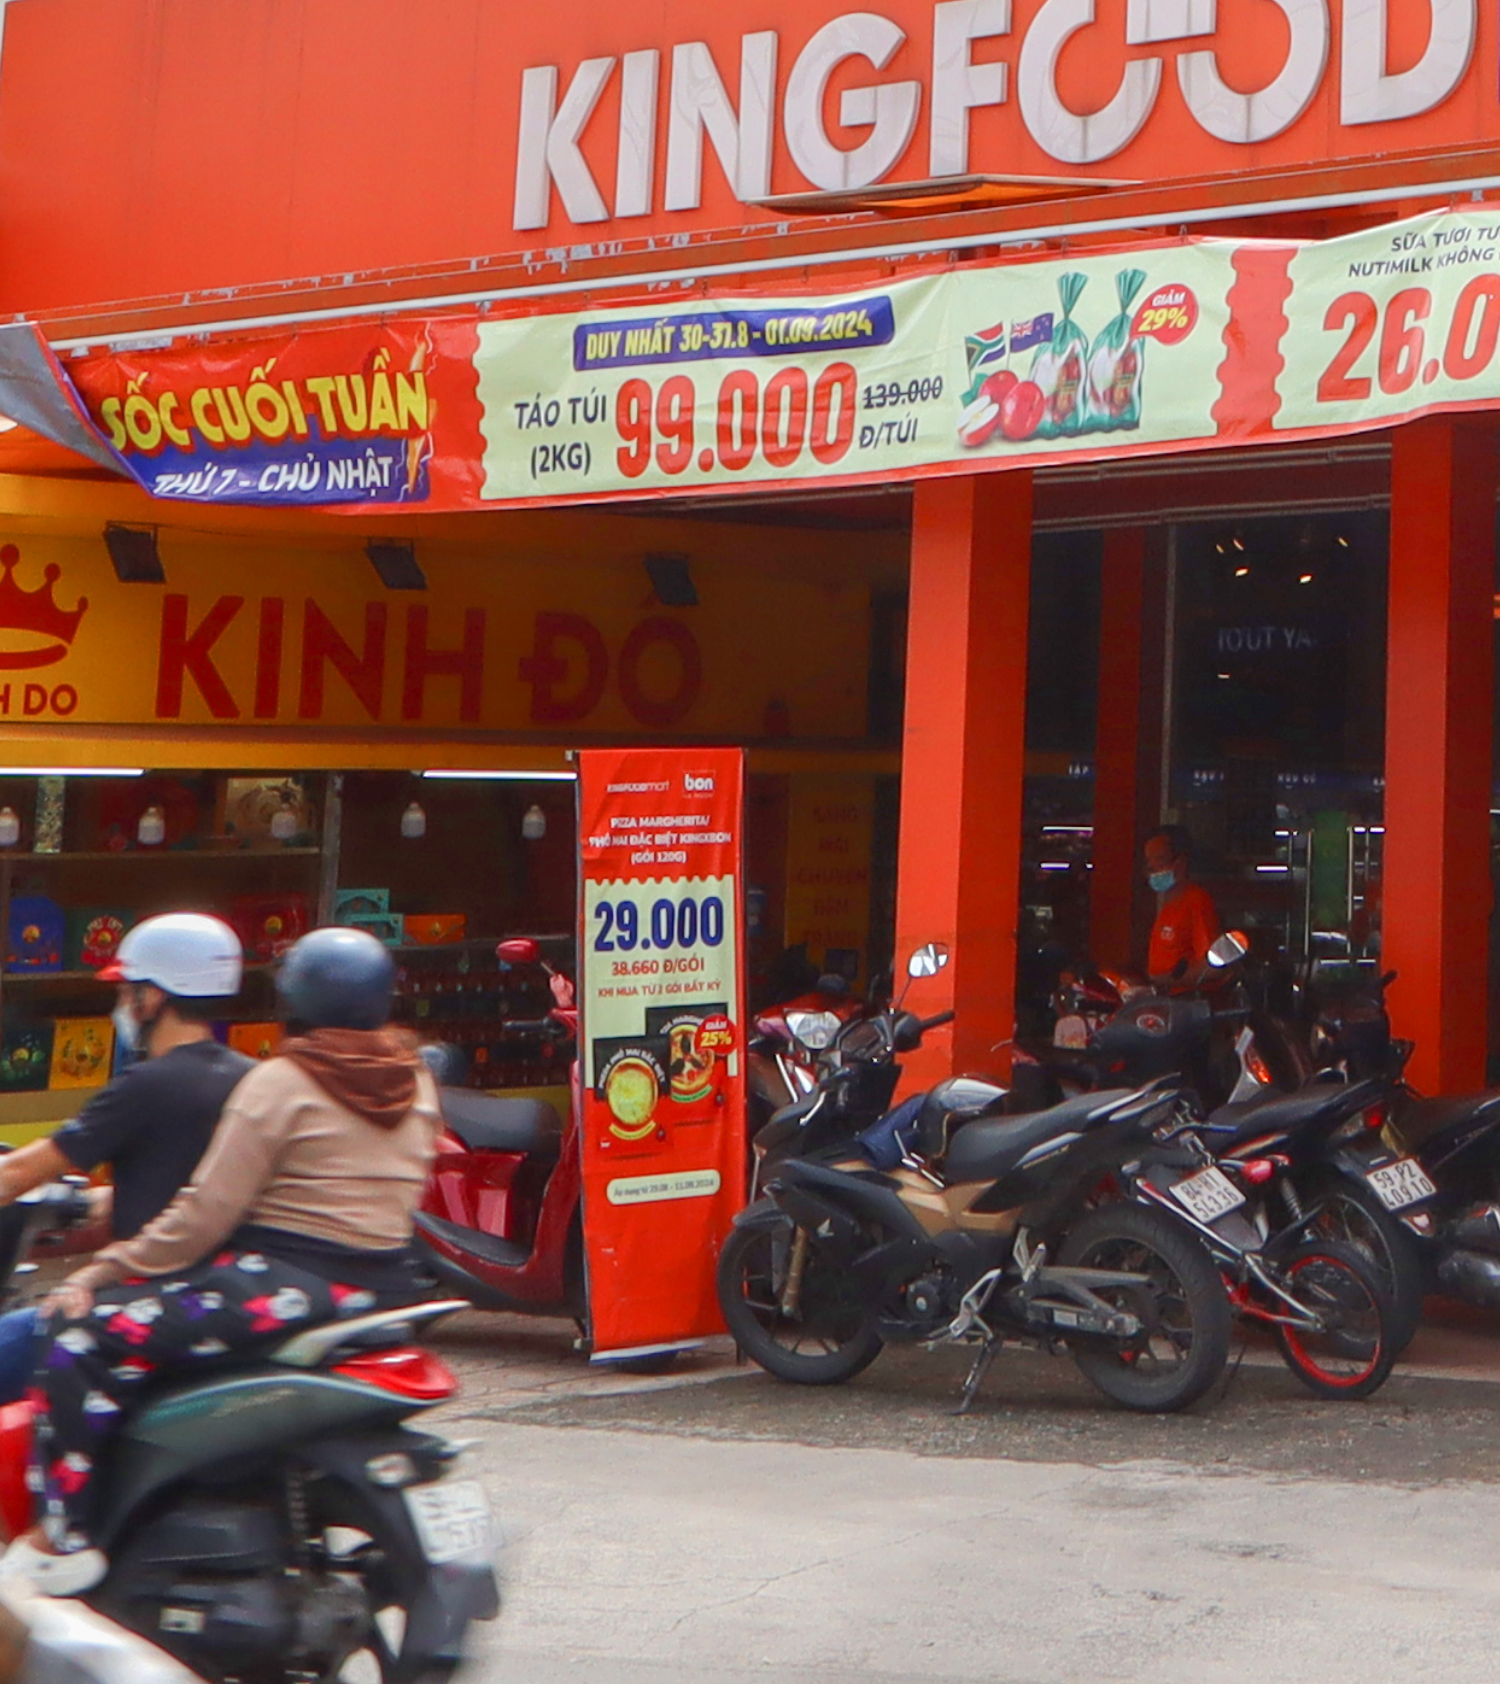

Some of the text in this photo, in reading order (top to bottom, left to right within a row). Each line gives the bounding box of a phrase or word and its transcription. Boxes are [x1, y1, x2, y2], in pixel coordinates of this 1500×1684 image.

[1389, 226, 1426, 252] SỮA
[1432, 221, 1472, 247] TƯƠI
[1347, 254, 1433, 279] NUTIMILK
[1436, 240, 1493, 269] KHÔNG
[1138, 307, 1189, 332] 29%
[585, 329, 619, 360] DUY
[624, 318, 676, 356] NHẤT
[101, 349, 429, 452] SỐC CUỐI TUẦN
[513, 380, 608, 430] TÁO TÚI
[862, 376, 943, 410] 139.000
[615, 361, 857, 477] 99.000
[858, 411, 918, 449] Đ/TÚI
[152, 452, 392, 499] THỨ 7 CHỦ NHẬT
[529, 442, 592, 480] (2KG)
[155, 594, 487, 722] KINH
[23, 683, 79, 716] DO
[684, 773, 713, 791] bon
[593, 896, 724, 953] 29.000
[611, 953, 705, 976] 38.660 Đ/GÓI
[700, 1030, 733, 1047] 25%
